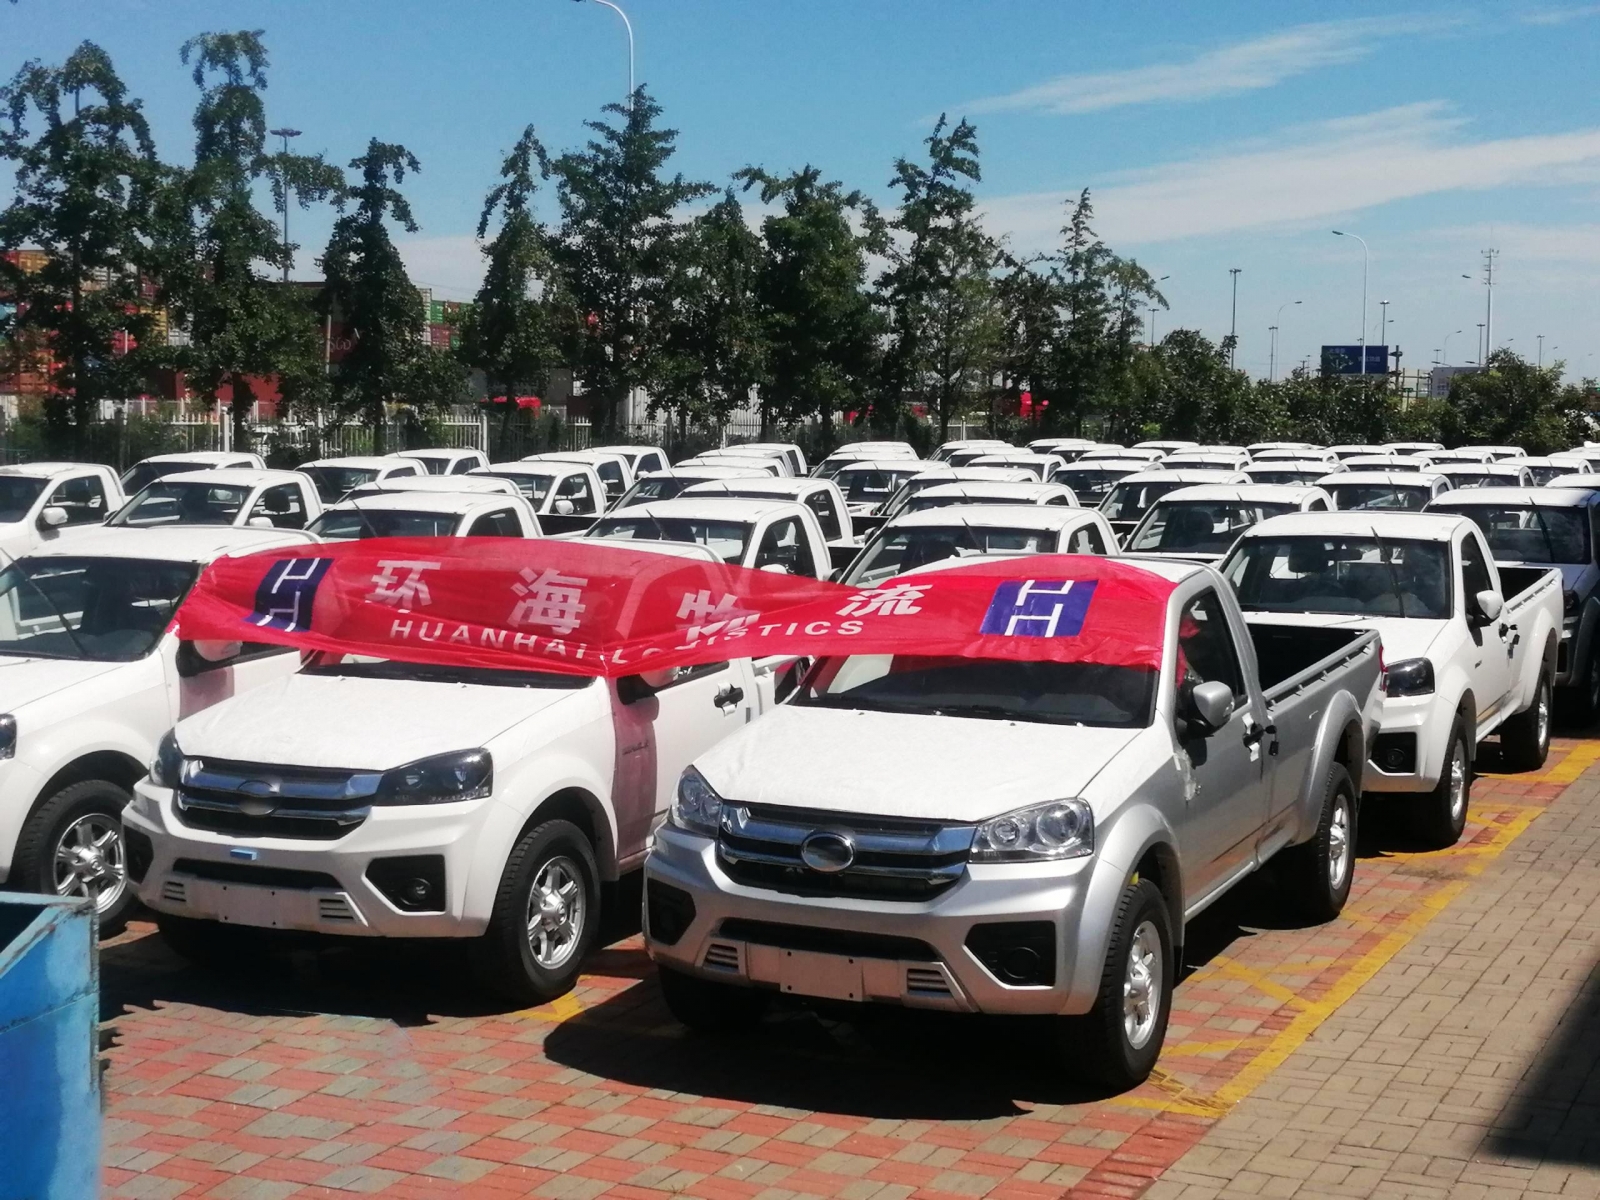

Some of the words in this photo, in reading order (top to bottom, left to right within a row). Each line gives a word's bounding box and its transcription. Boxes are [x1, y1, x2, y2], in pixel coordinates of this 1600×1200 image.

[365, 559, 934, 644] 环海物流
[389, 619, 588, 660] HUANHAI
